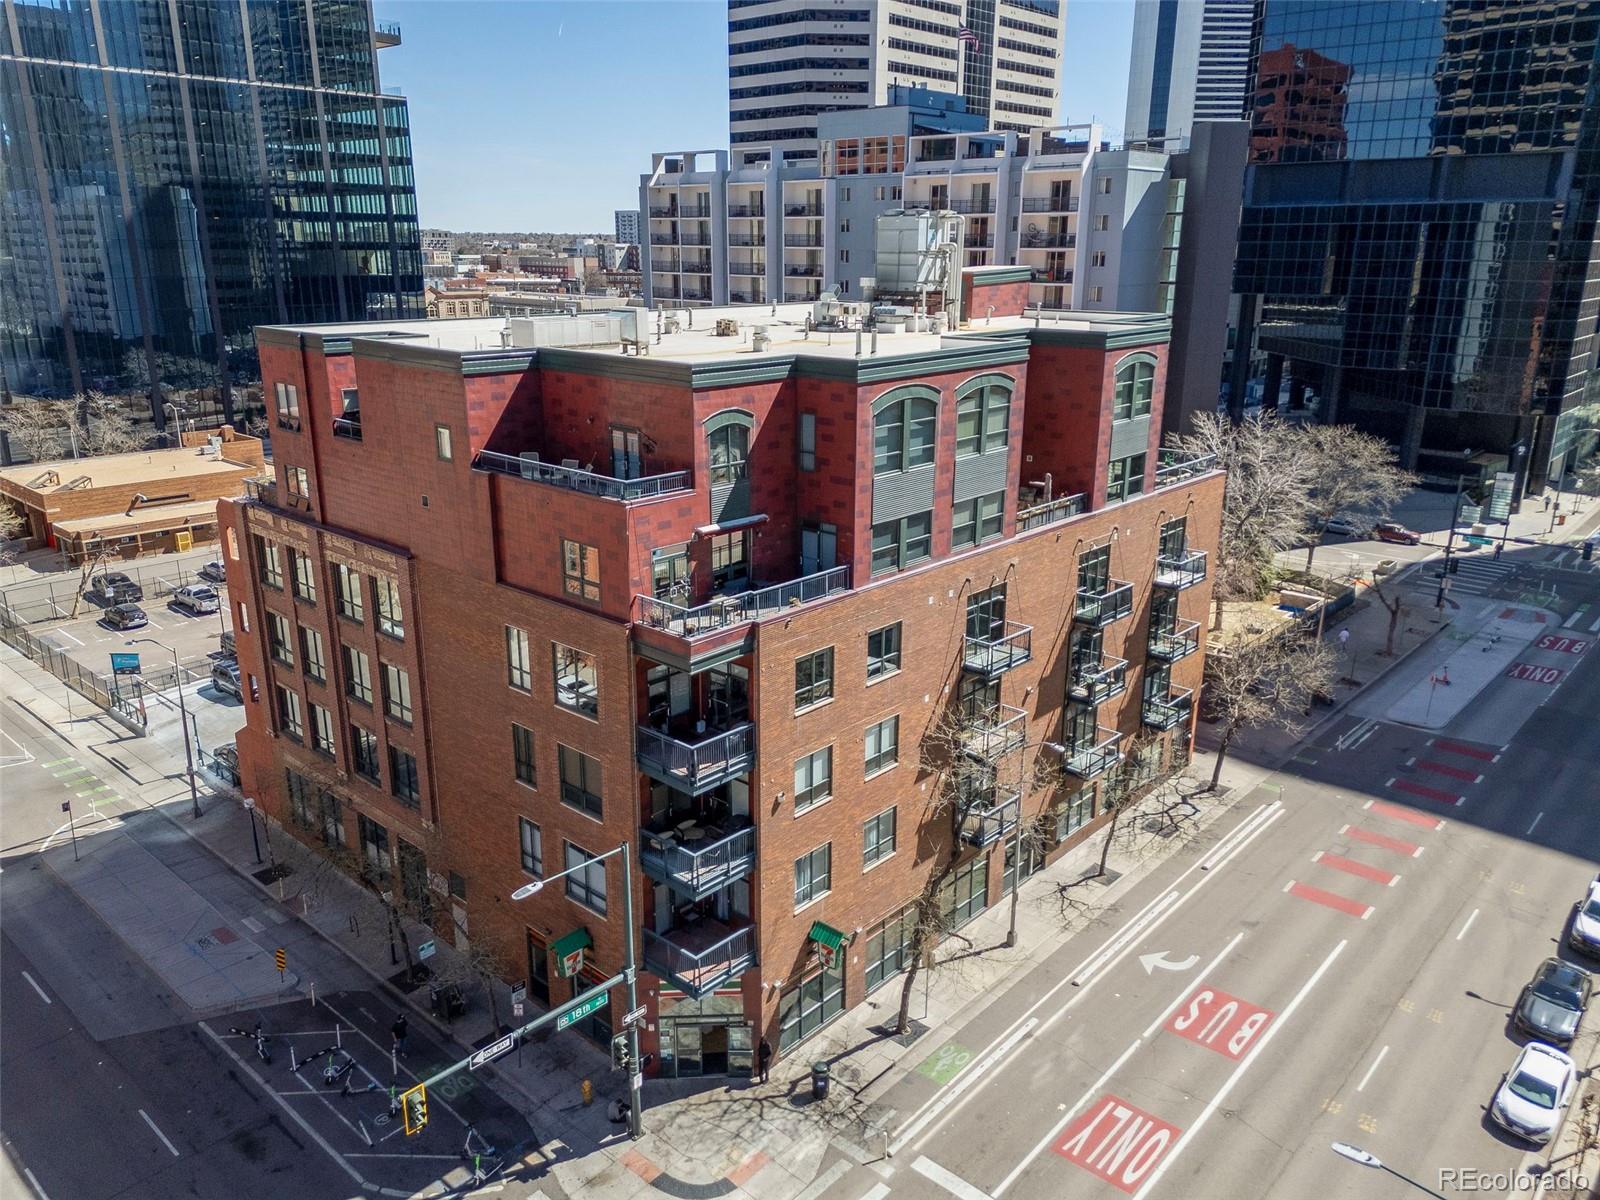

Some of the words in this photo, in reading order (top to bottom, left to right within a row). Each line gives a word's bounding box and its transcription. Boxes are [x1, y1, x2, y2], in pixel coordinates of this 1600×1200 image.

[1539, 636, 1586, 653] BUS
[1508, 663, 1559, 683] ONLY
[571, 1003, 591, 1021] 18th
[1174, 990, 1269, 1056] BUS
[482, 1047, 495, 1059] ONE
[496, 1040, 509, 1052] WAY
[1061, 1101, 1171, 1184] ONLY
